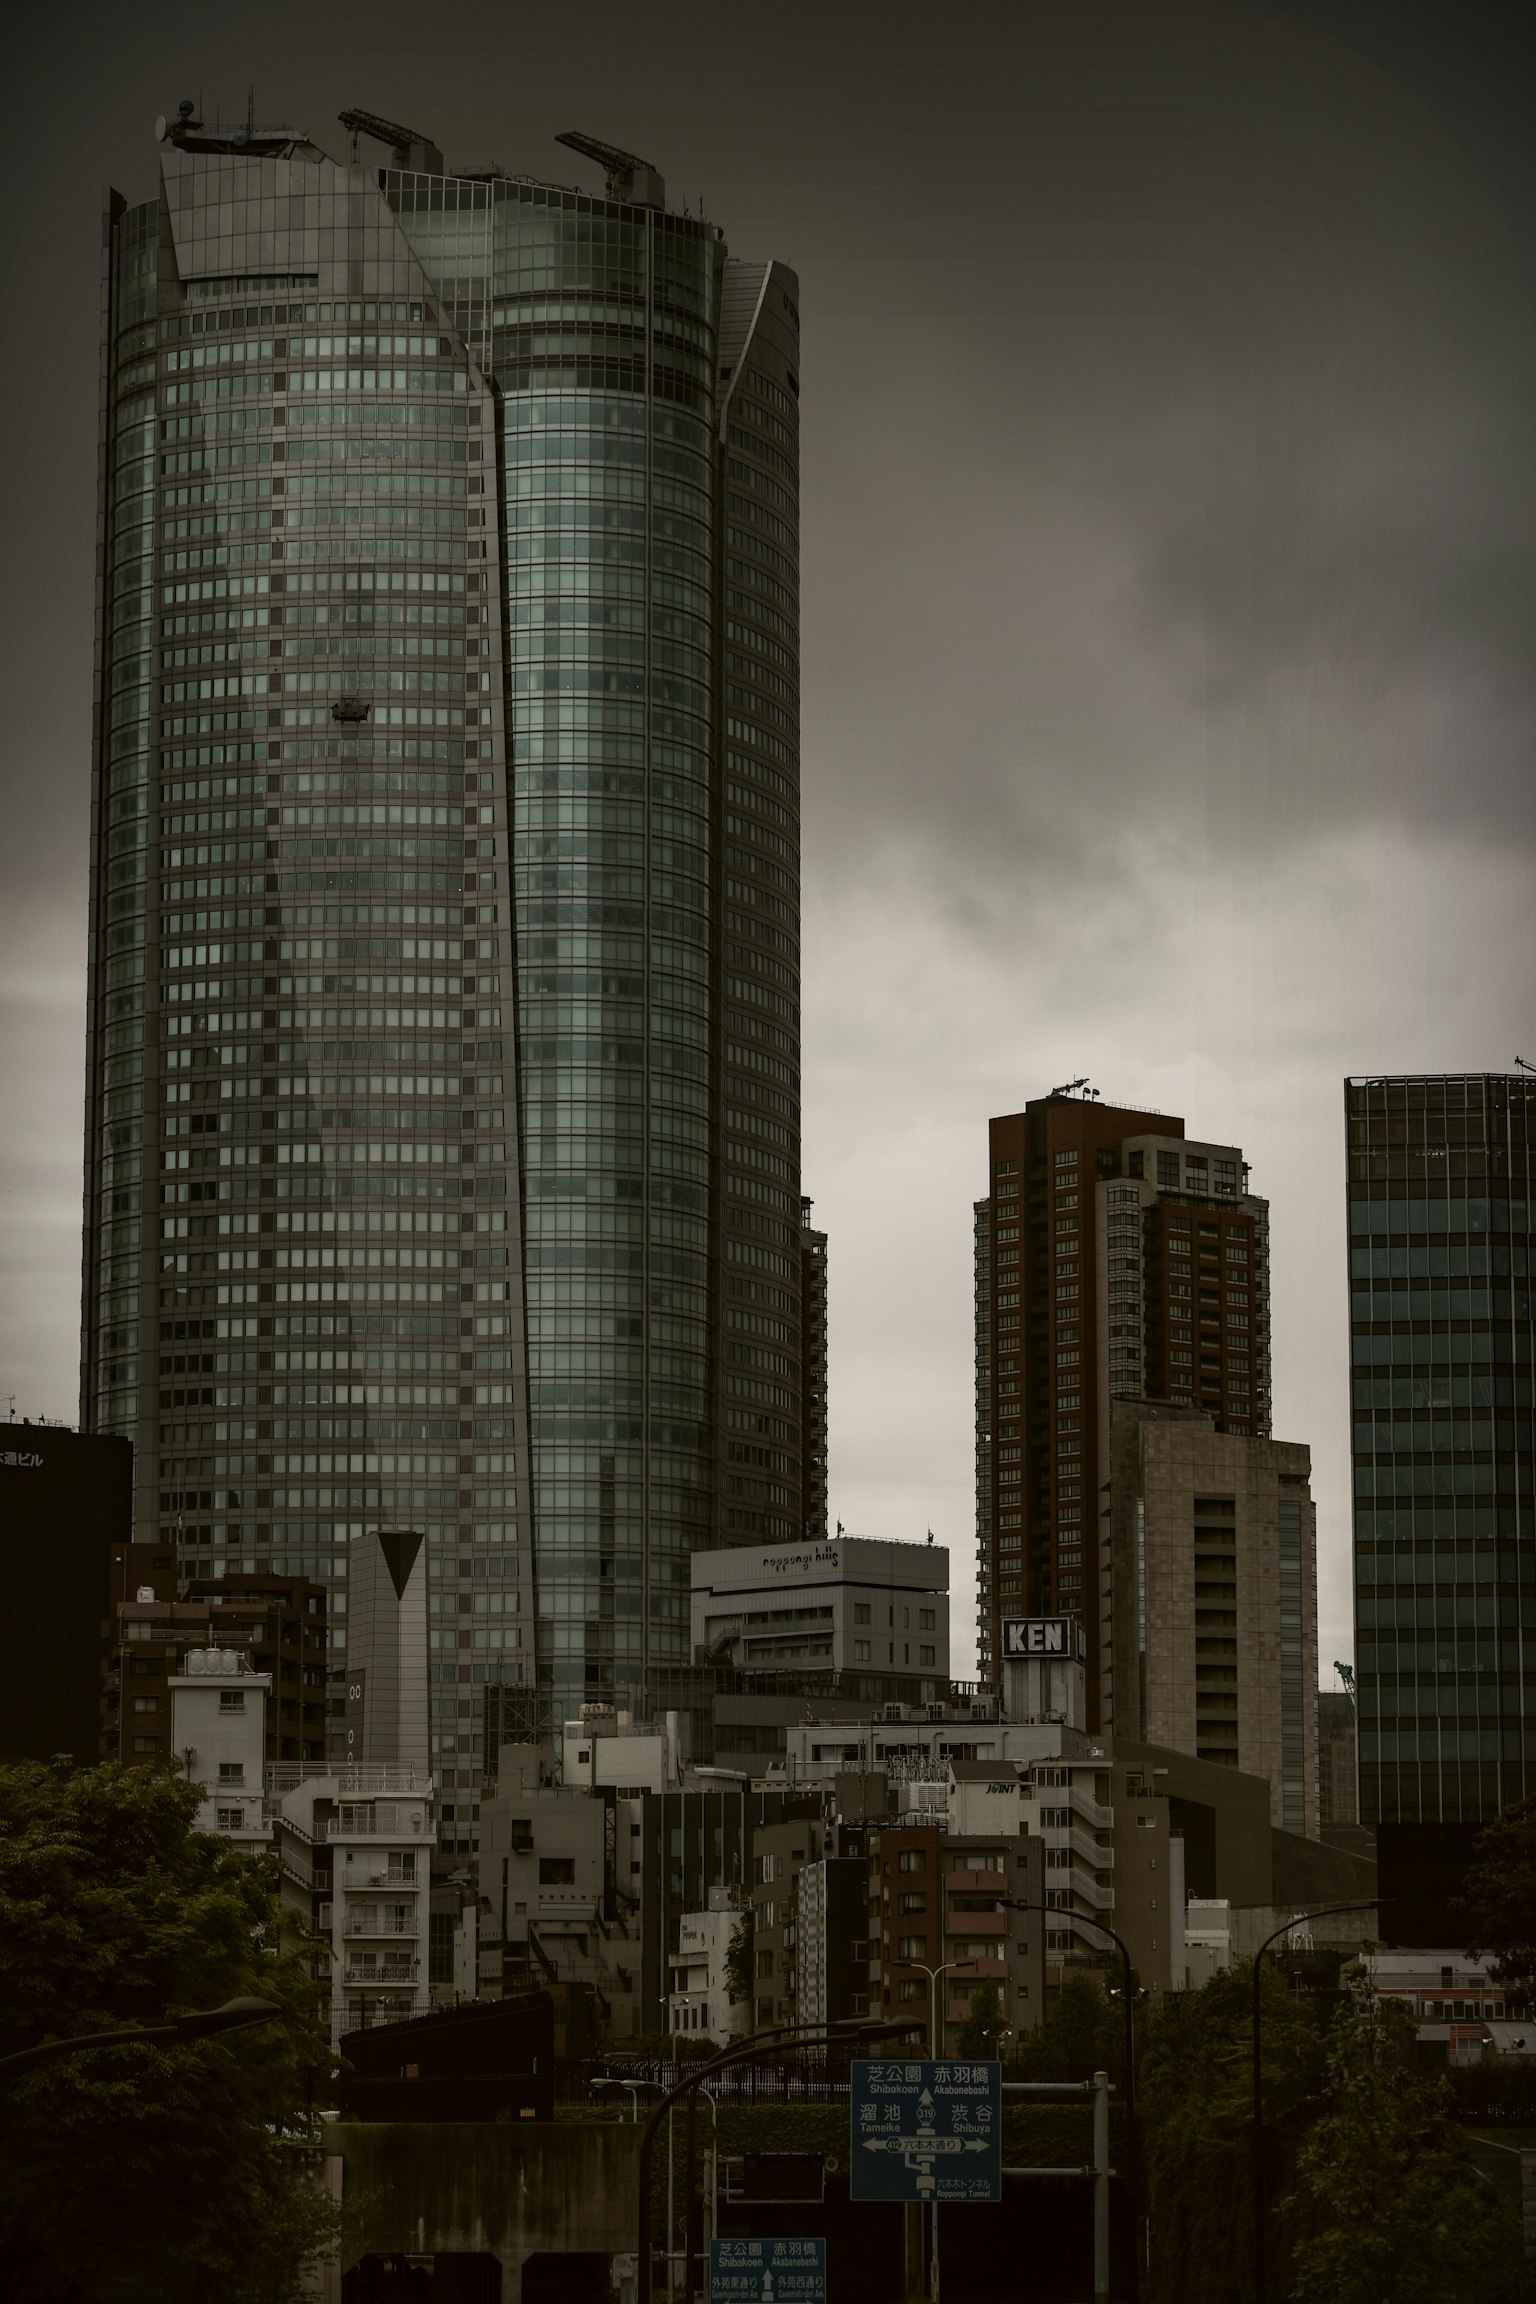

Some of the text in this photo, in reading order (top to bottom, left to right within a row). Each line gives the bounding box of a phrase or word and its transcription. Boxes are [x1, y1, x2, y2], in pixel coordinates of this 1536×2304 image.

[763, 1546, 838, 1572] roppongi hills
[1008, 1623, 1062, 1651] KEN
[867, 2065, 922, 2083] 芝公園
[934, 2066, 989, 2084] 赤羽橋
[870, 2084, 919, 2094] Shibakoen
[934, 2085, 990, 2095] Akabanebashi
[918, 2109, 934, 2119] 319
[860, 2122, 901, 2132] Tameike
[953, 2123, 991, 2134] Shibuya
[904, 2140, 956, 2150] 六本木通り
[936, 2178, 991, 2190] 六本木トンネル
[936, 2190, 991, 2199] Roppongi Tunnel
[719, 2242, 762, 2256] 芝公園
[773, 2242, 816, 2256] 赤羽橋
[718, 2257, 763, 2267] Shibakoen
[771, 2257, 819, 2267] Akabanebashi
